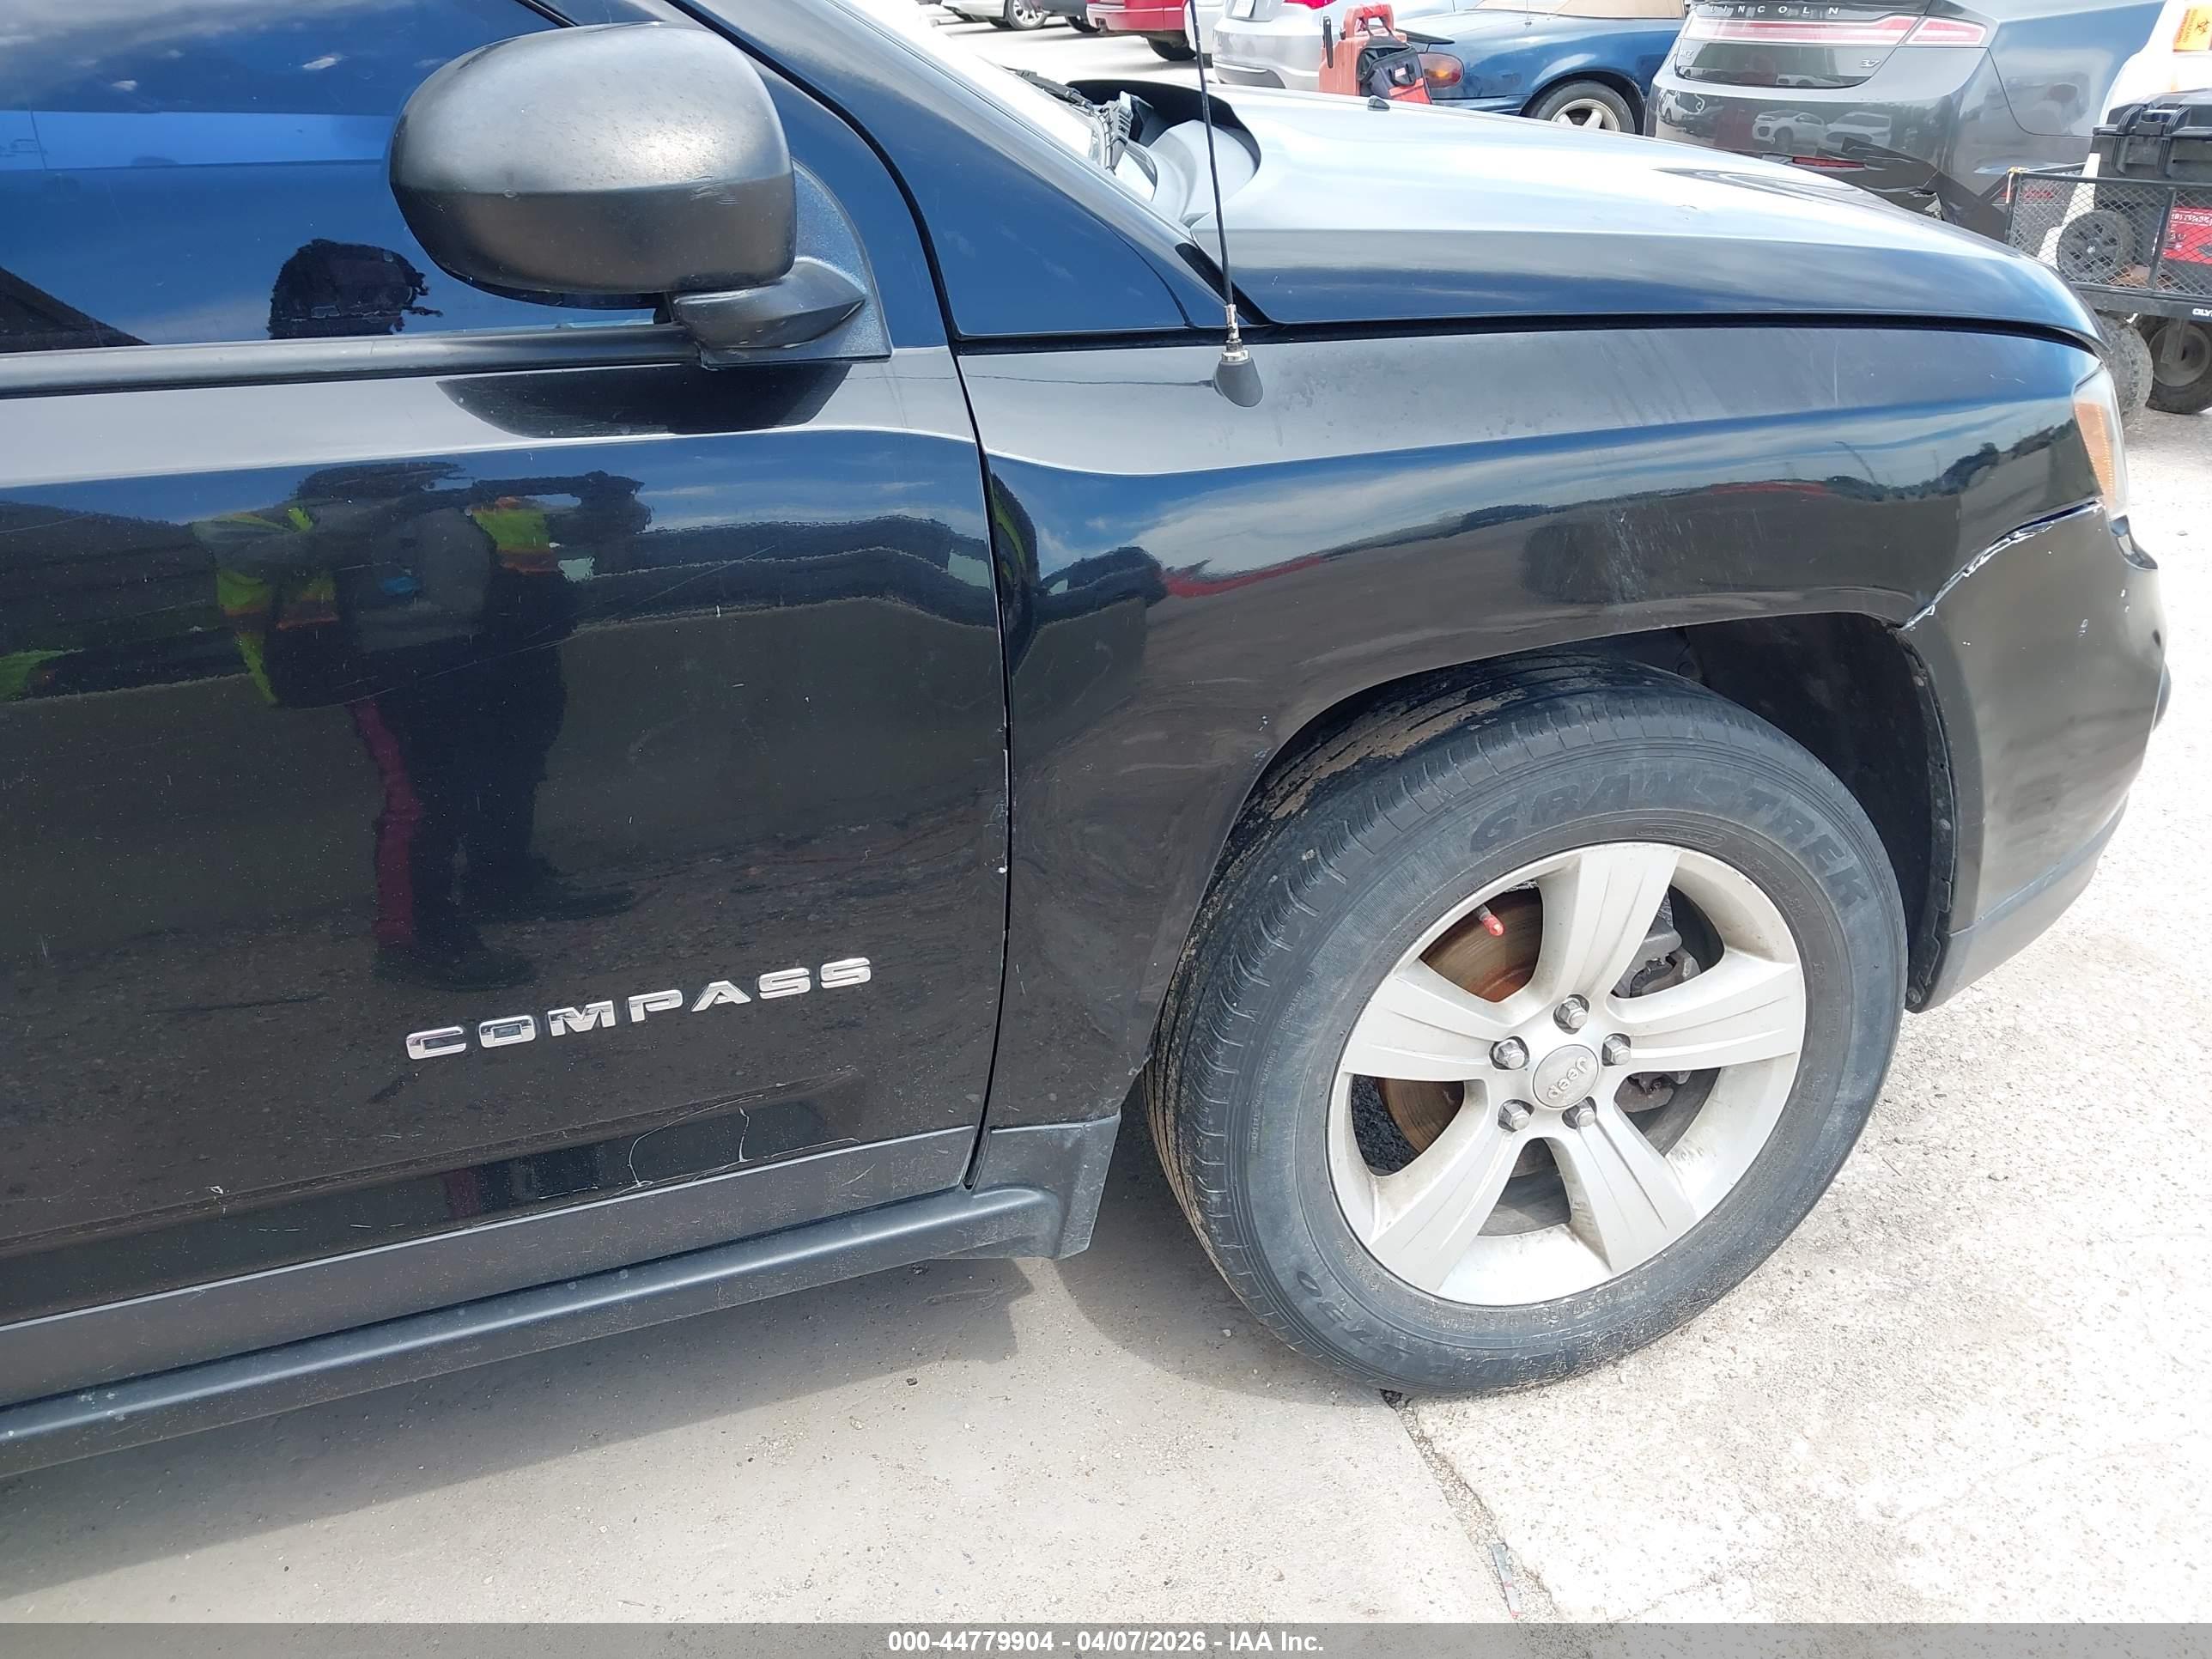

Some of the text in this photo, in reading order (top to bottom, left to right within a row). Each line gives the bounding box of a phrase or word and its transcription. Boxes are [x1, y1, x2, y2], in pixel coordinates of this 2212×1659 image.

[1710, 5, 1839, 15] LINCOLN
[2191, 307, 2212, 317] OLY
[405, 957, 872, 1060] COMPASS
[1547, 1055, 1588, 1100] Jeep
